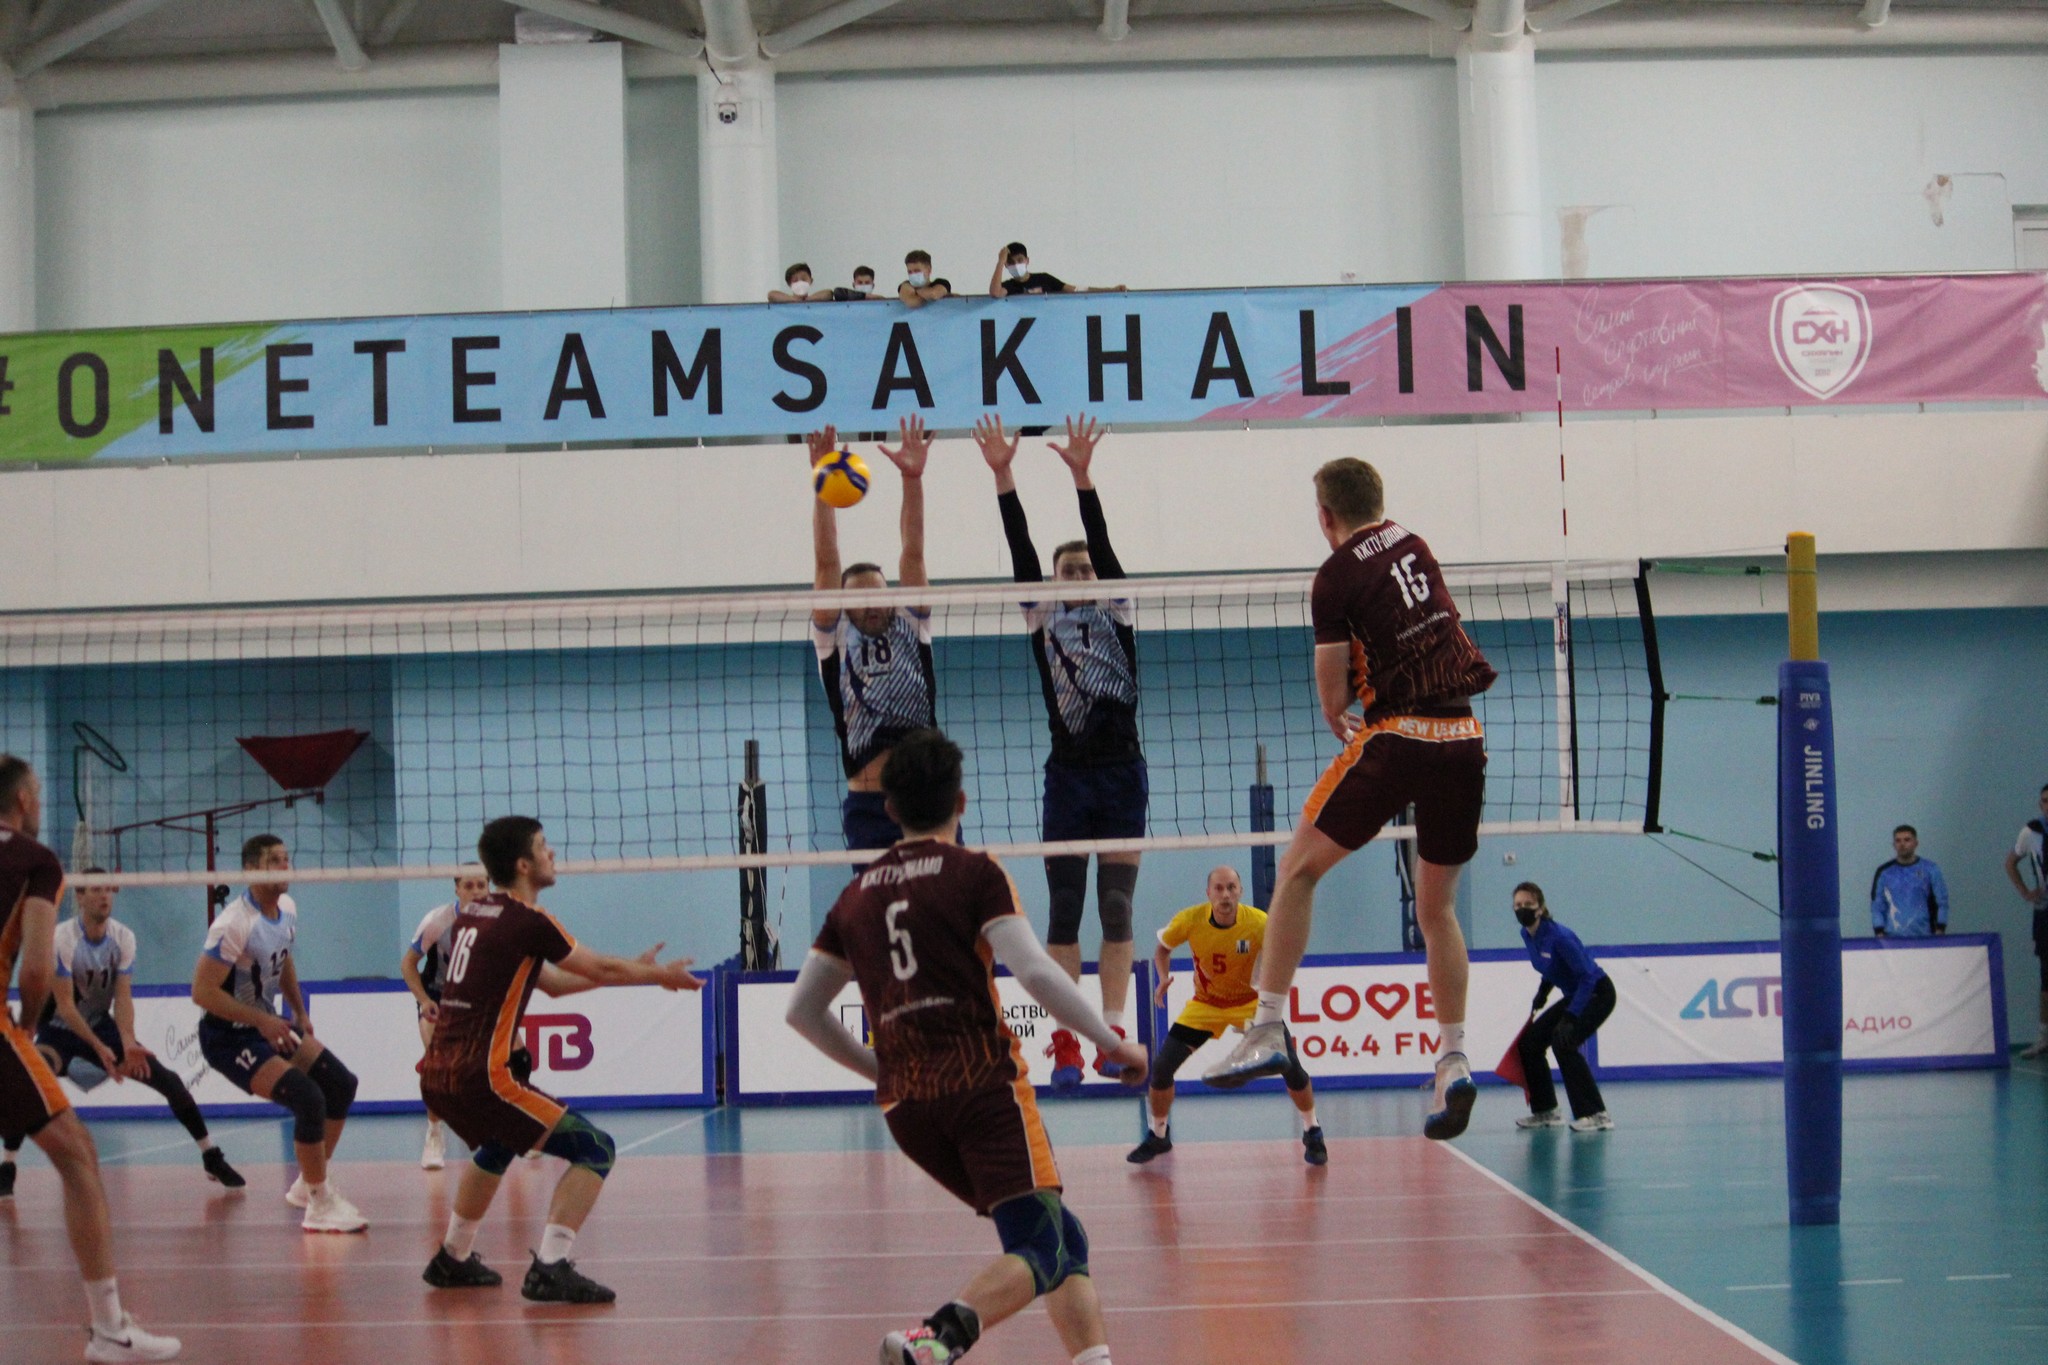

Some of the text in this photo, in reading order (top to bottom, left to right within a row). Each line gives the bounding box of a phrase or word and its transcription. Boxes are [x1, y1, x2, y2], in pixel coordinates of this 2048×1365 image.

[0, 304, 1526, 438] ONETEAMSAKHALIN
[1390, 552, 1430, 610] 15
[861, 636, 891, 667] 18
[1803, 744, 1825, 829] JINLING
[446, 926, 478, 984] 16
[886, 899, 918, 981] 5
[1212, 953, 1227, 974] 5
[1001, 1005, 1048, 1019] ЬСТВО
[1679, 976, 1783, 1020] АСТ
[522, 1013, 594, 1071] ТВ
[1395, 1032, 1441, 1055] FM
[1845, 1016, 1912, 1034] АДИО
[235, 1049, 257, 1070] 12
